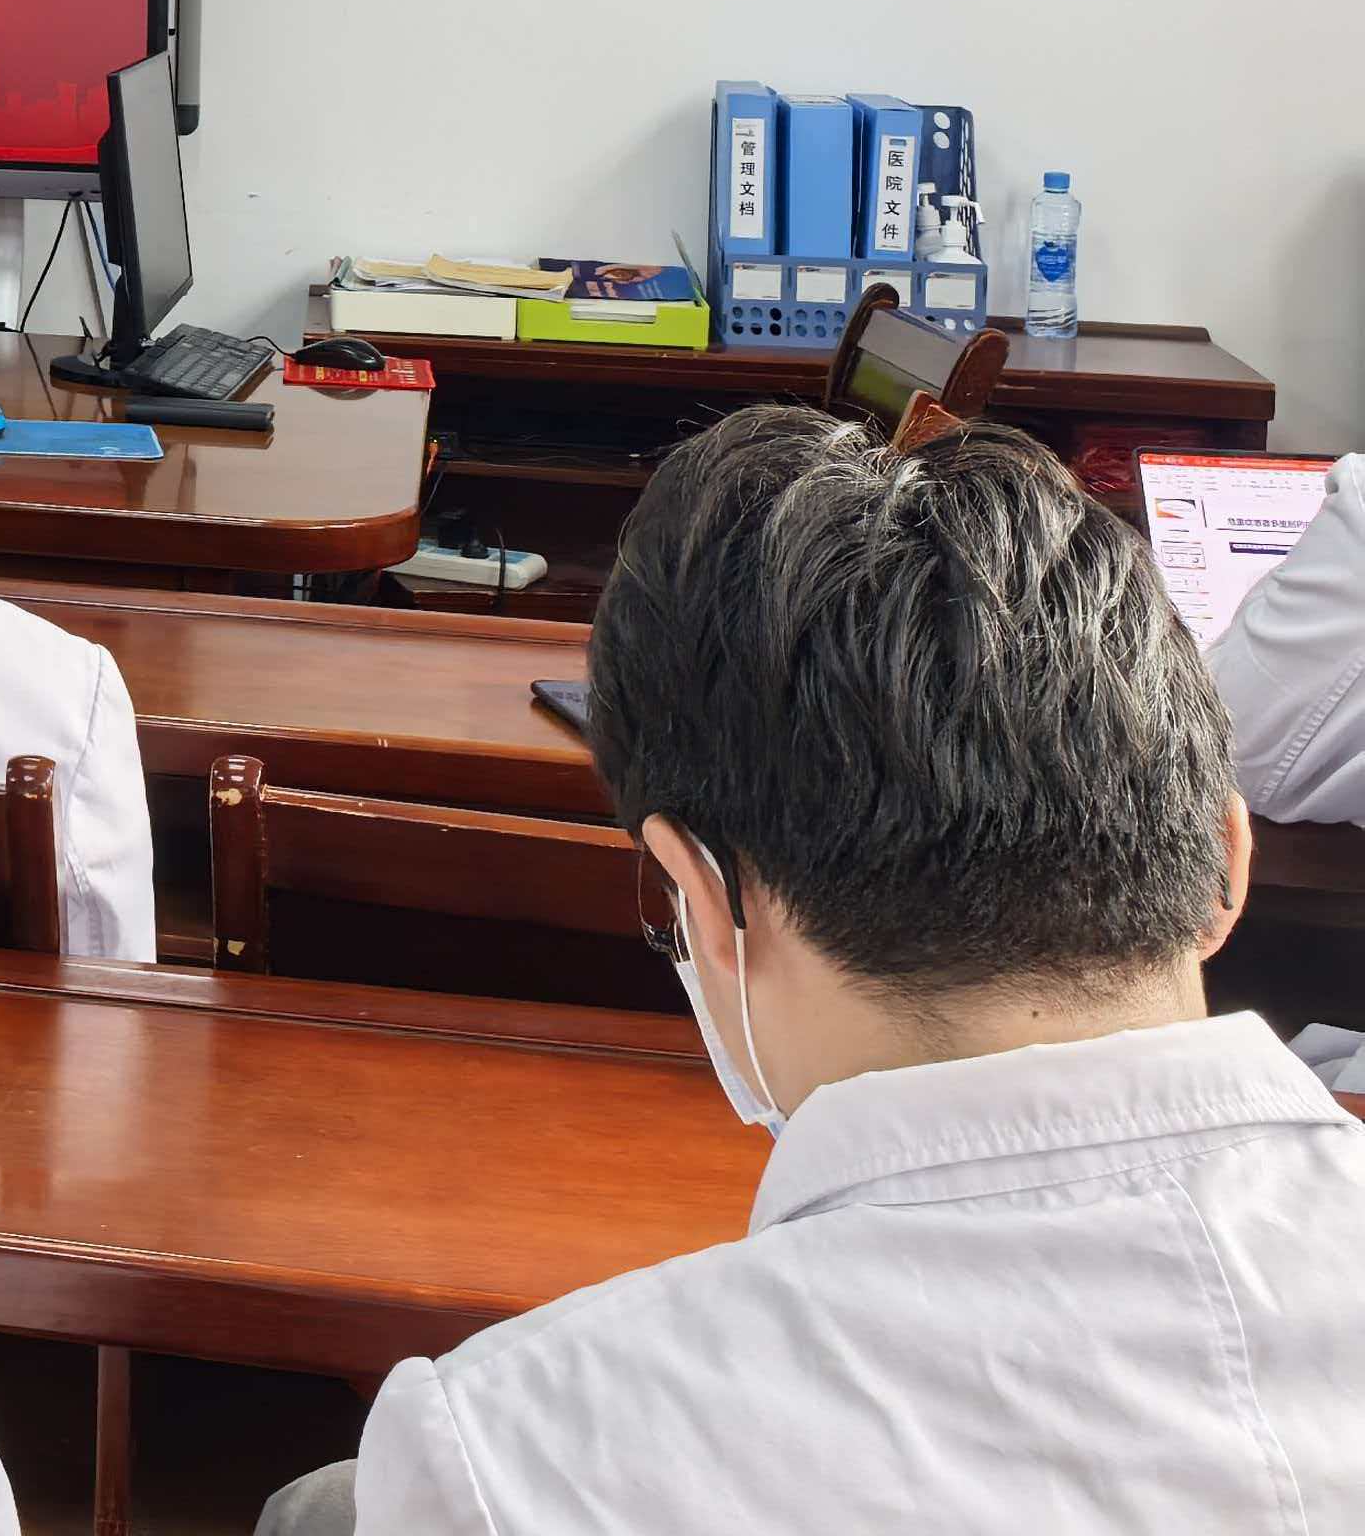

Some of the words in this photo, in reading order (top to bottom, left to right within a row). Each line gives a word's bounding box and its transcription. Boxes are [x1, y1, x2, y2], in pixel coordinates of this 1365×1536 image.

[739, 141, 757, 216] 管理文档
[882, 151, 905, 239] 医院文件
